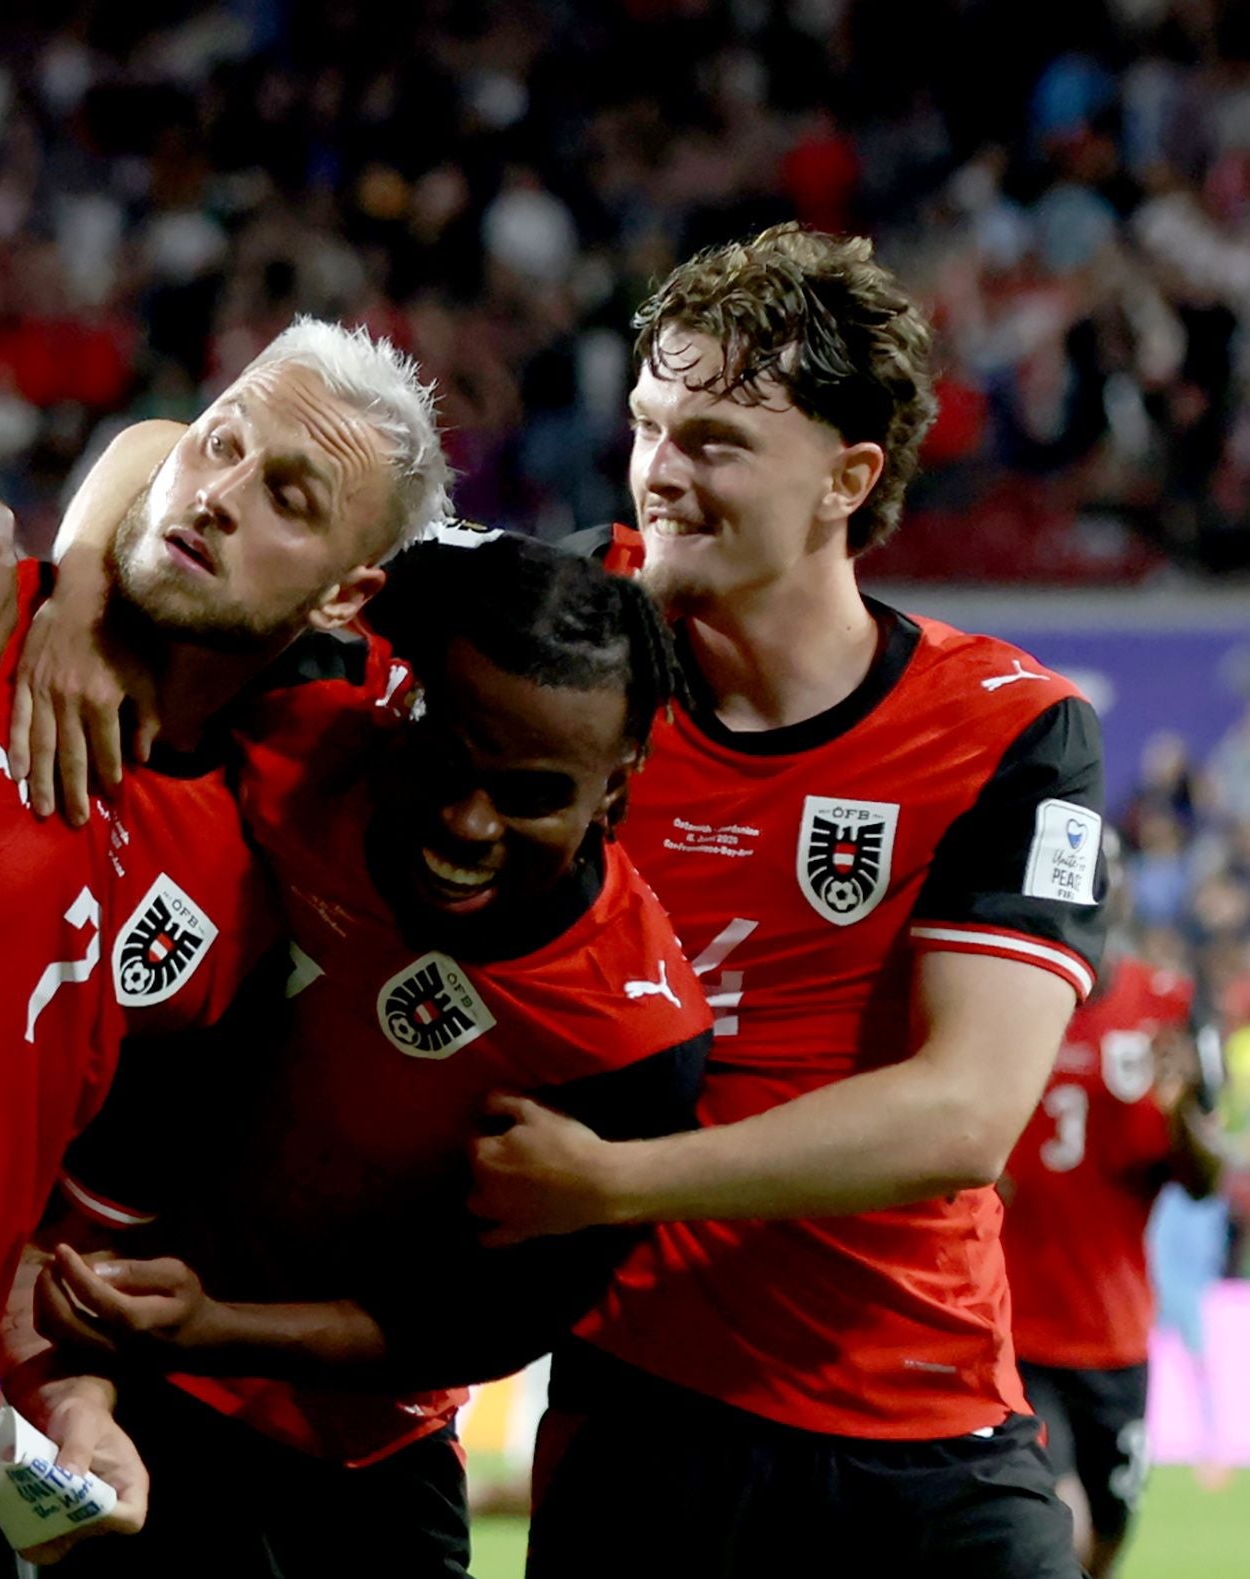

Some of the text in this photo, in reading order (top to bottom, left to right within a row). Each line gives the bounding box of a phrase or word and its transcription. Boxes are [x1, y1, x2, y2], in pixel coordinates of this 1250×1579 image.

[832, 806, 870, 820] ÖFB
[24, 885, 101, 1043] 7
[1040, 1083, 1089, 1172] 3
